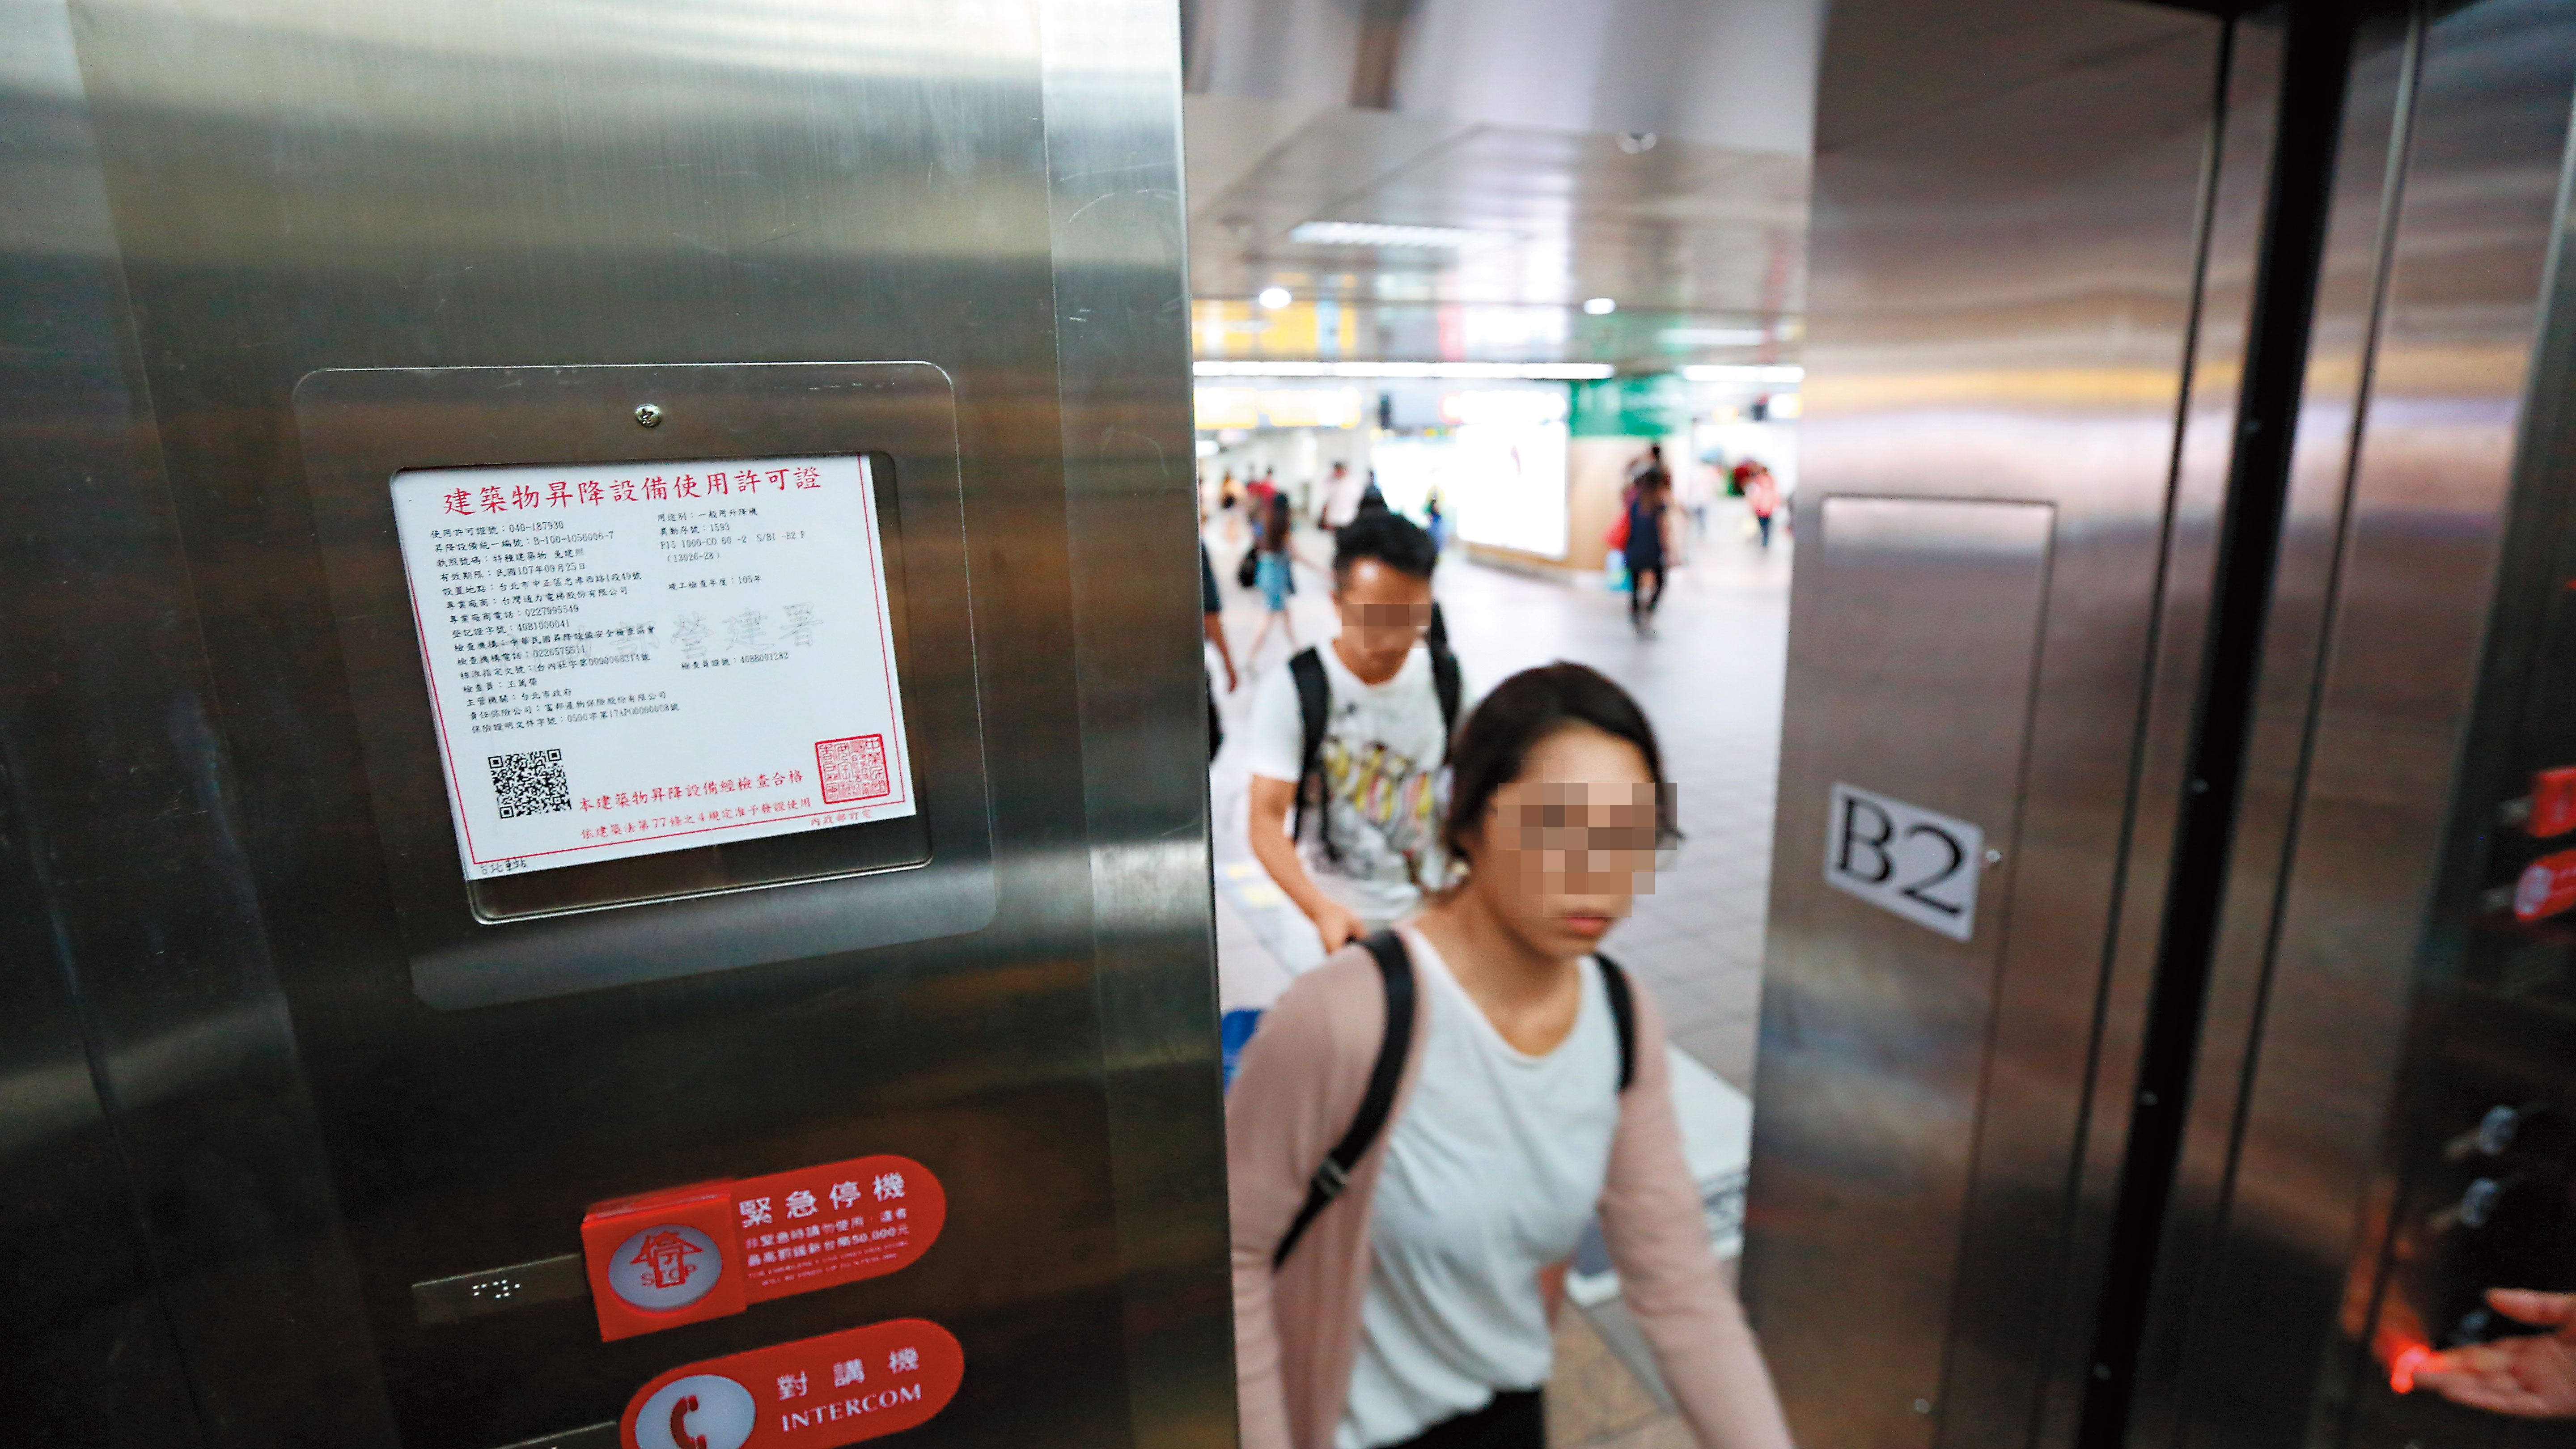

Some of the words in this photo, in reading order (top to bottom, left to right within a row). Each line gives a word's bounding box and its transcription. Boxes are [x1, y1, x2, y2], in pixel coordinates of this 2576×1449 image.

[444, 466, 822, 516] 建築物昇降設備使用許可證
[580, 769, 804, 812] 本建築物昇降設備經檢查合格
[1838, 795, 1966, 917] B2
[739, 1172, 905, 1228] 緊急停機
[776, 1346, 919, 1401] 對講機
[781, 1383, 922, 1432] INTERCOM
